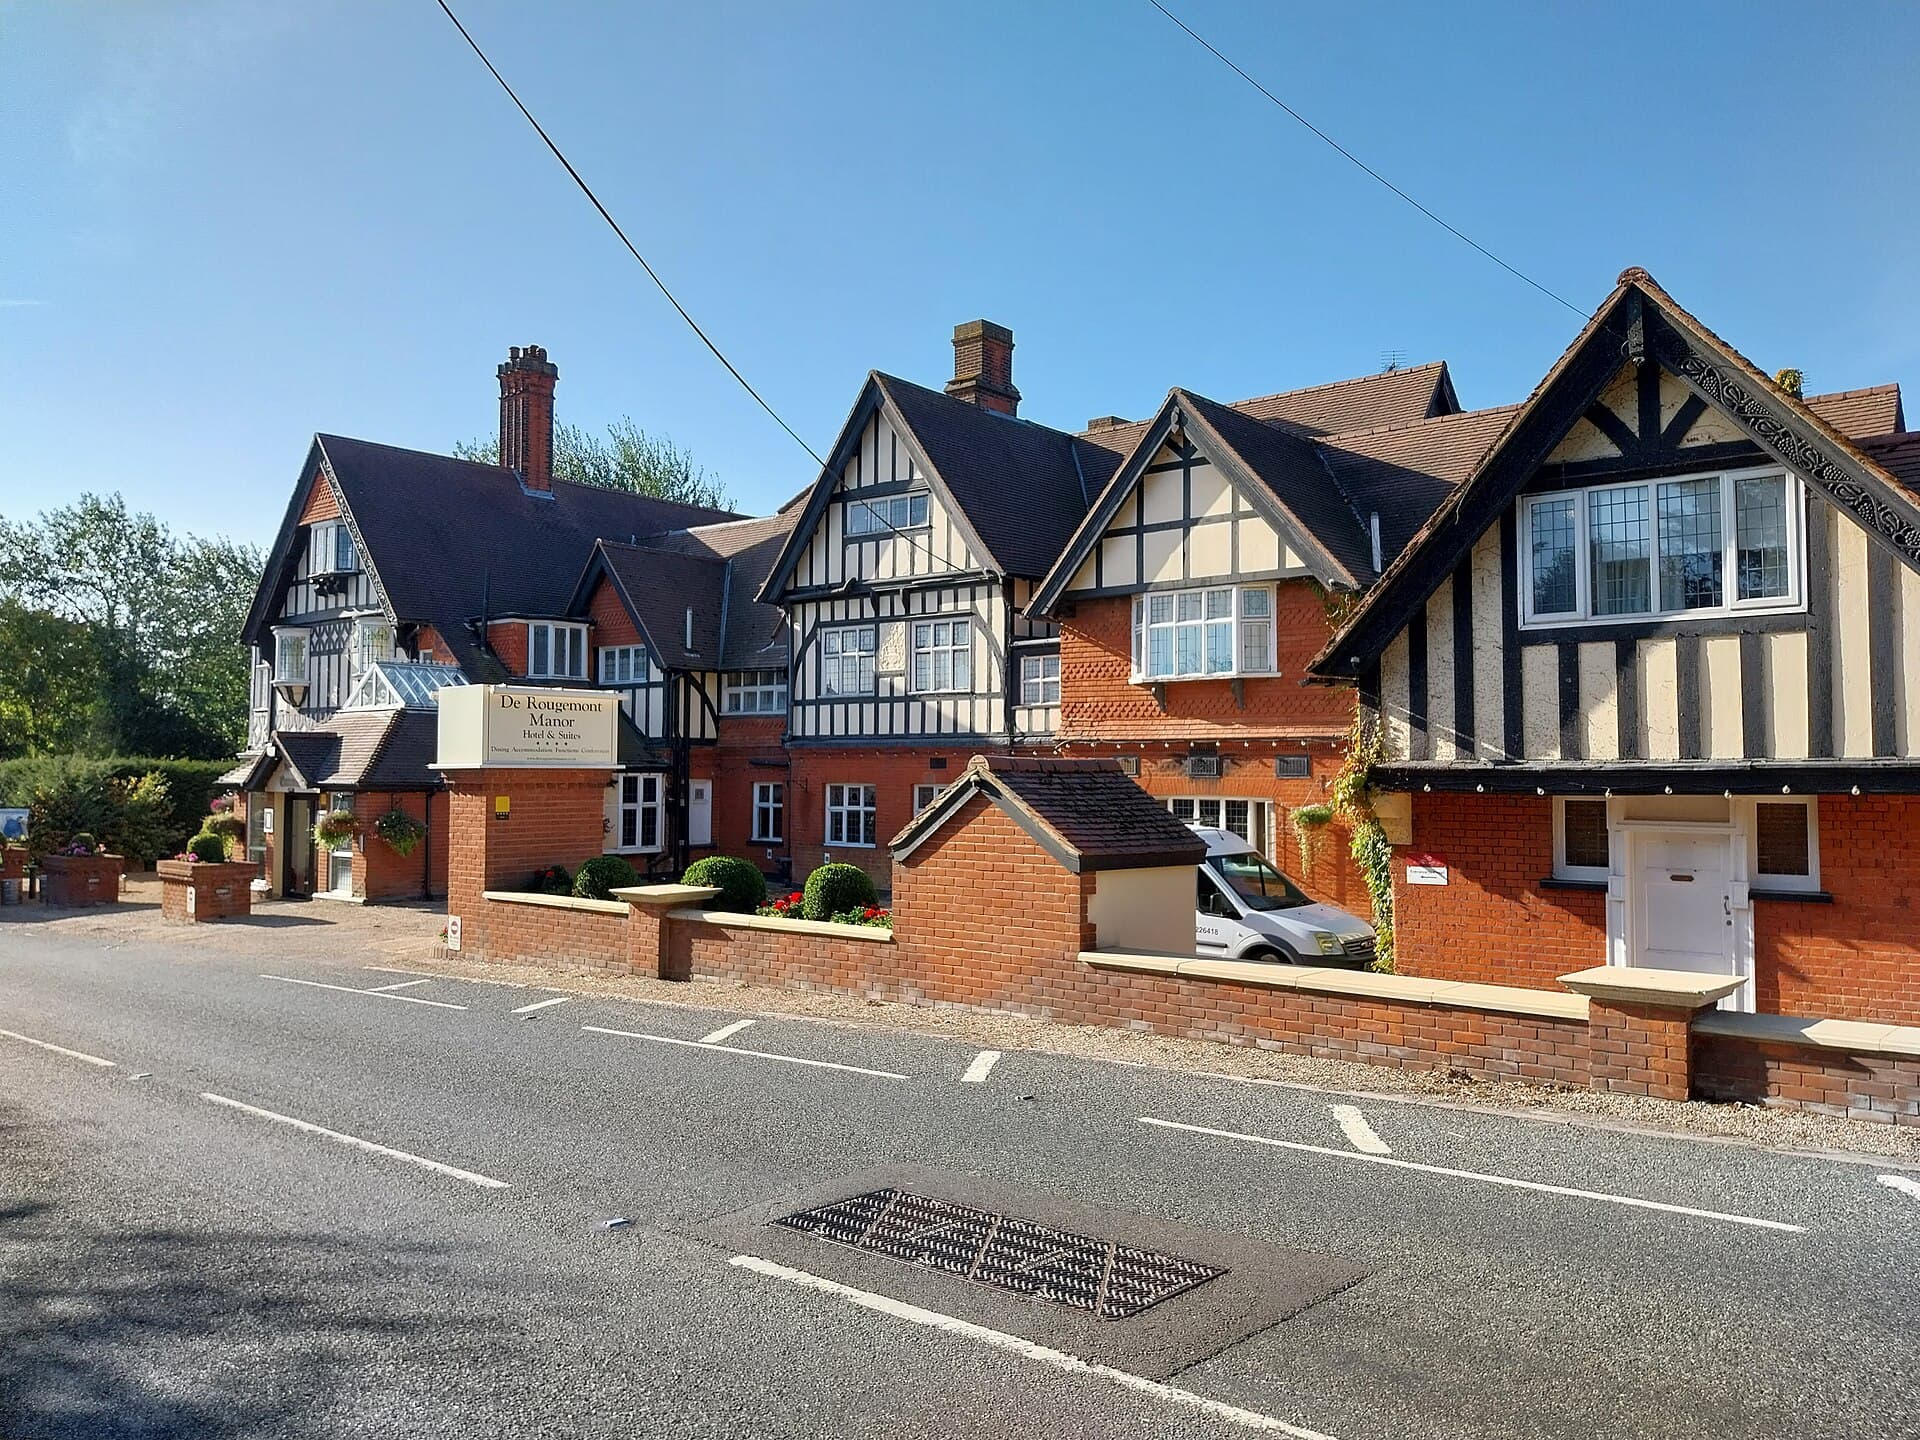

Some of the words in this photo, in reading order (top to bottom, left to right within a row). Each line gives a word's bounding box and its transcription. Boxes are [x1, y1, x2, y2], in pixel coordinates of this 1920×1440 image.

[501, 695, 521, 709] De
[527, 696, 602, 713] Rougemont
[529, 713, 575, 728] Manor
[523, 730, 544, 739] Hotel
[546, 730, 555, 739] &
[558, 731, 581, 740] Suites
